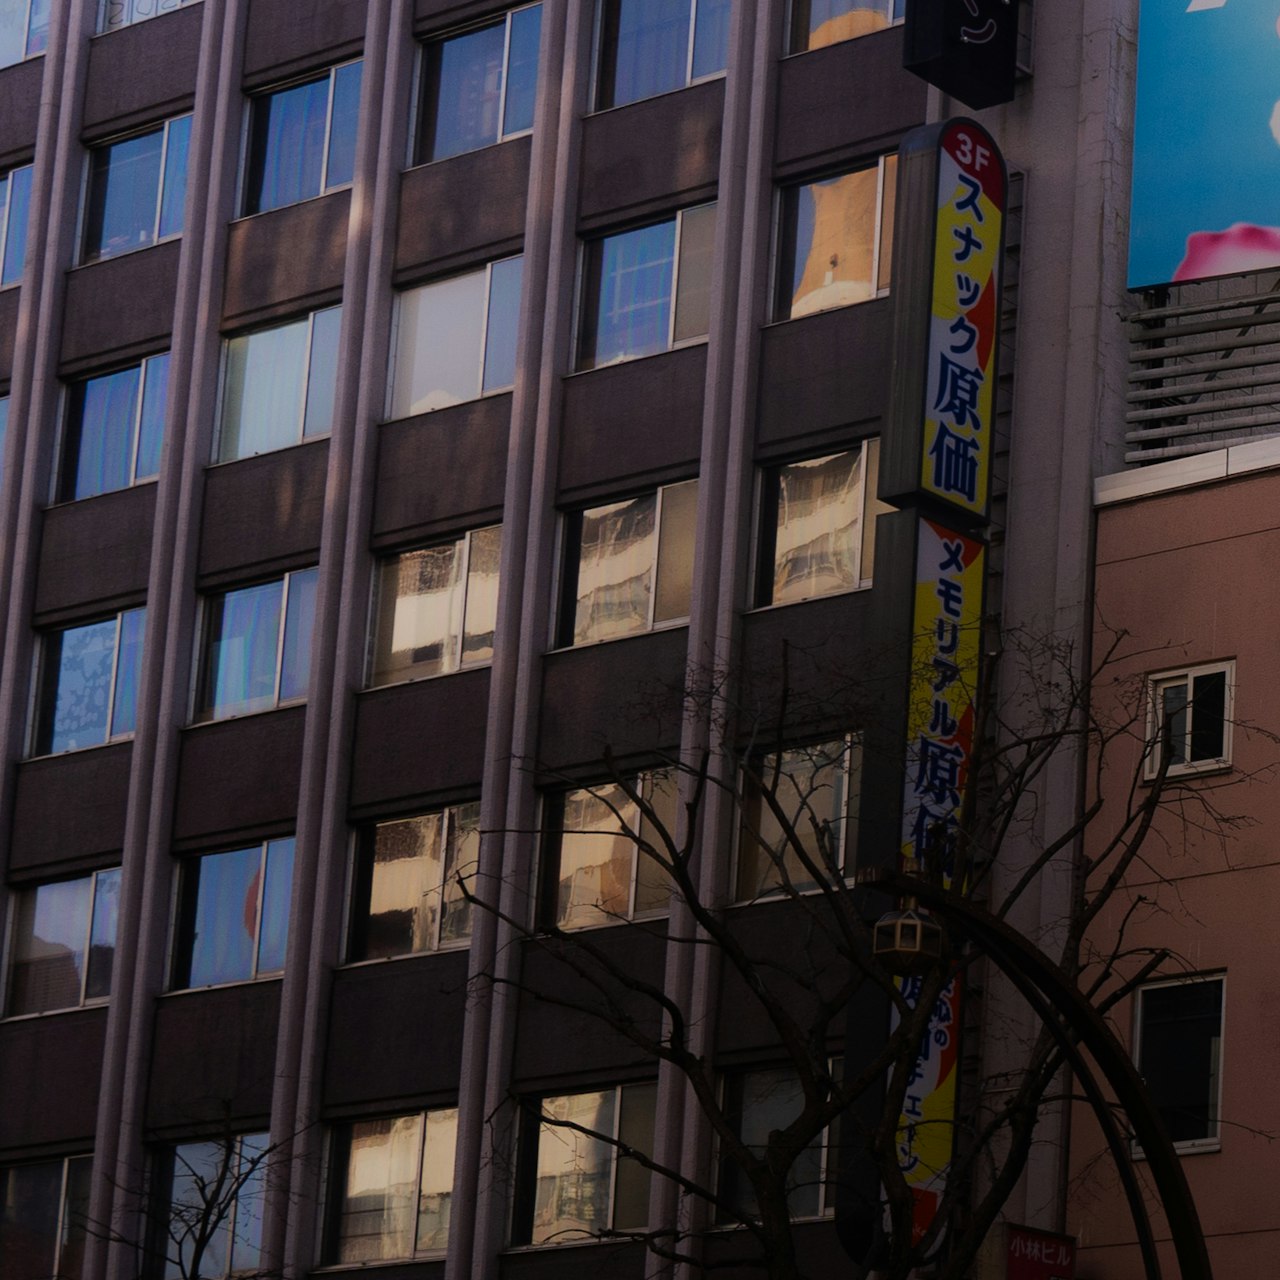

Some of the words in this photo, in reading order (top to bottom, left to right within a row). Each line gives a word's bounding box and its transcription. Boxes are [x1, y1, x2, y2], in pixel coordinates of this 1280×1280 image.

[954, 131, 991, 173] 3F
[929, 172, 985, 503] スナック原価
[1010, 1235, 1072, 1267] 小林ビル
